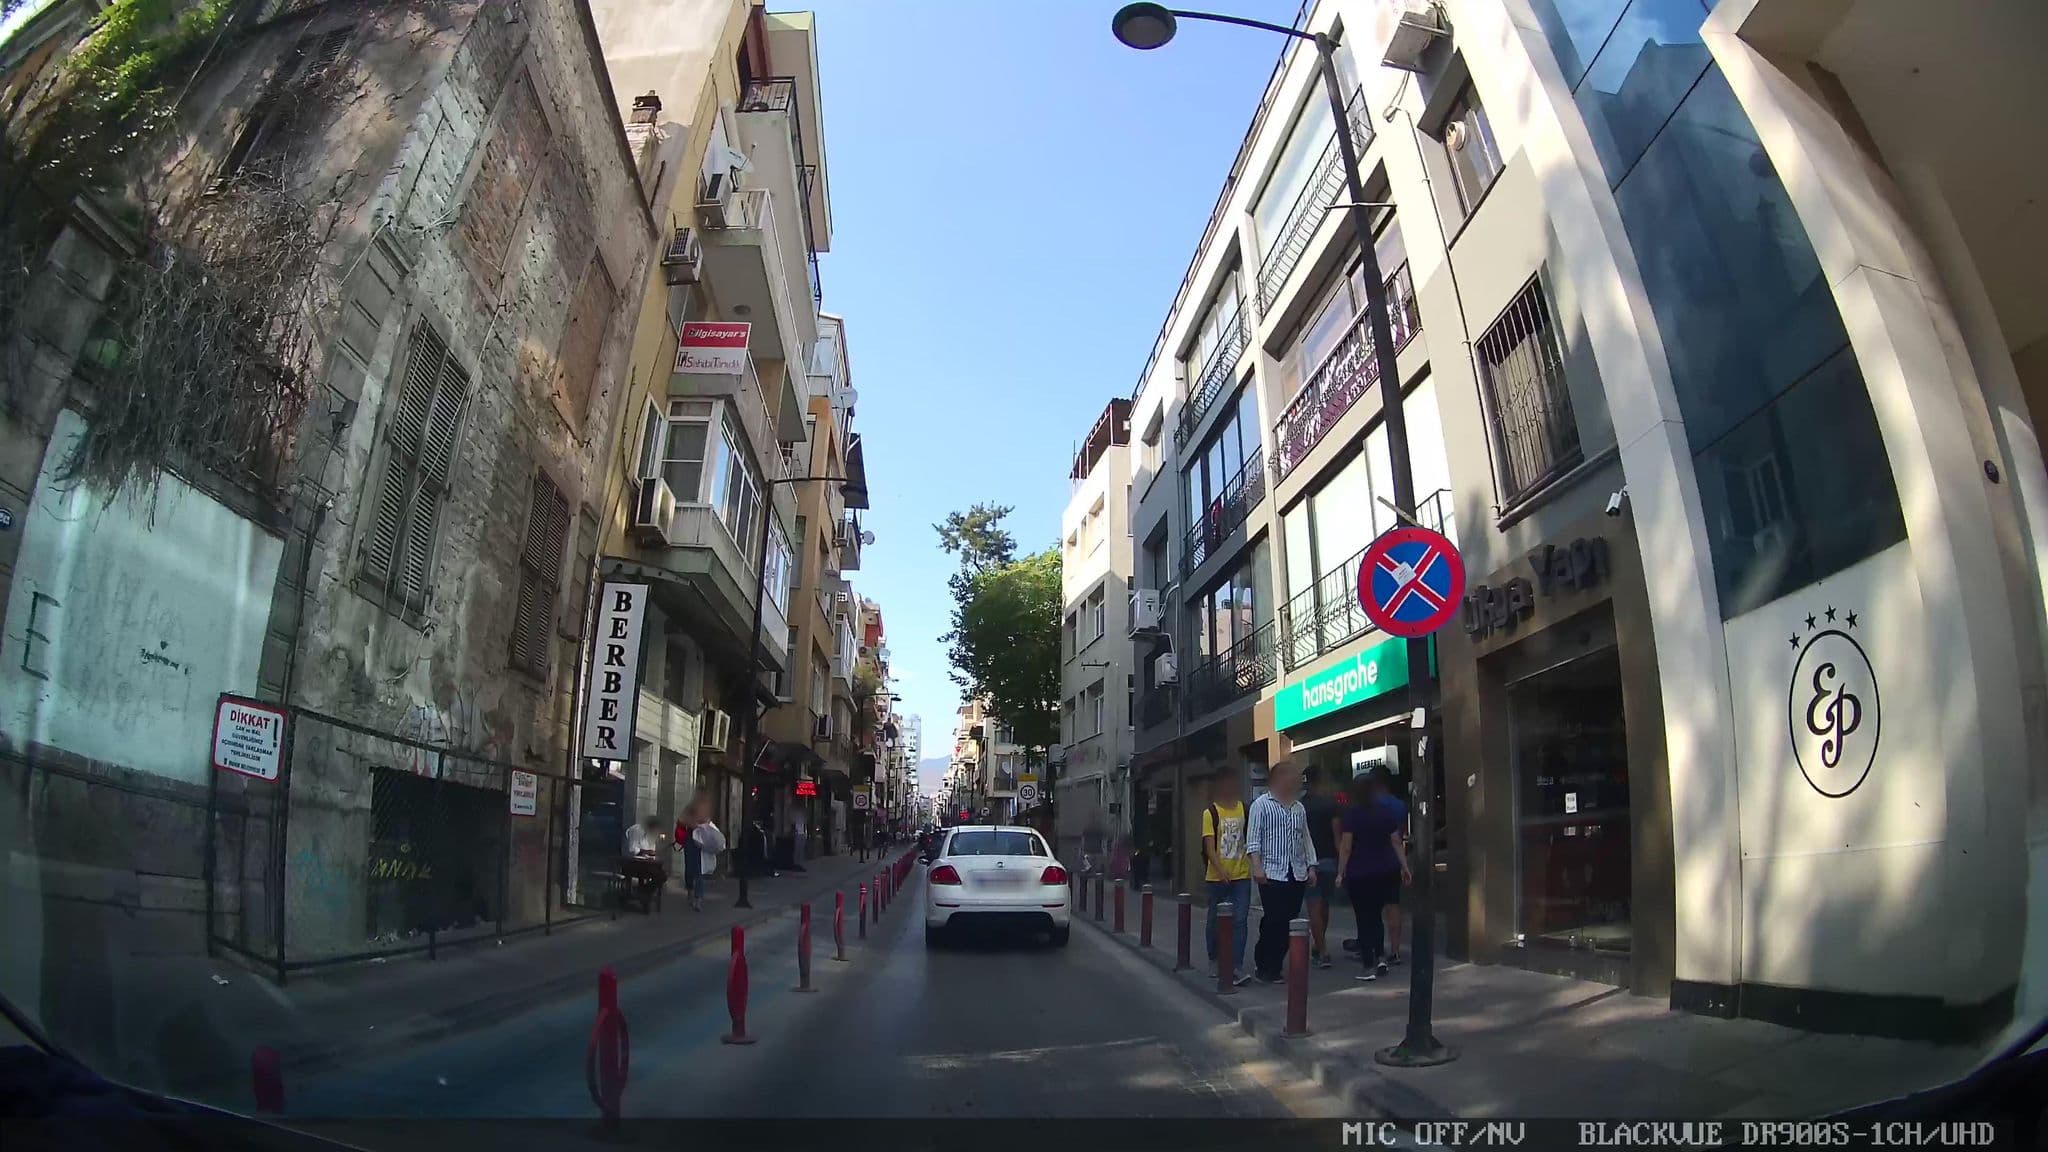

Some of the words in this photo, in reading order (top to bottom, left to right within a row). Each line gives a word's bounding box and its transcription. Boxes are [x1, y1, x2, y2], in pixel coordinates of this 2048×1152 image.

[595, 590, 632, 750] BERBER
[1302, 652, 1378, 711] hansgrohe
[230, 708, 271, 730] DİKKAT
[1023, 788, 1033, 797] 30
